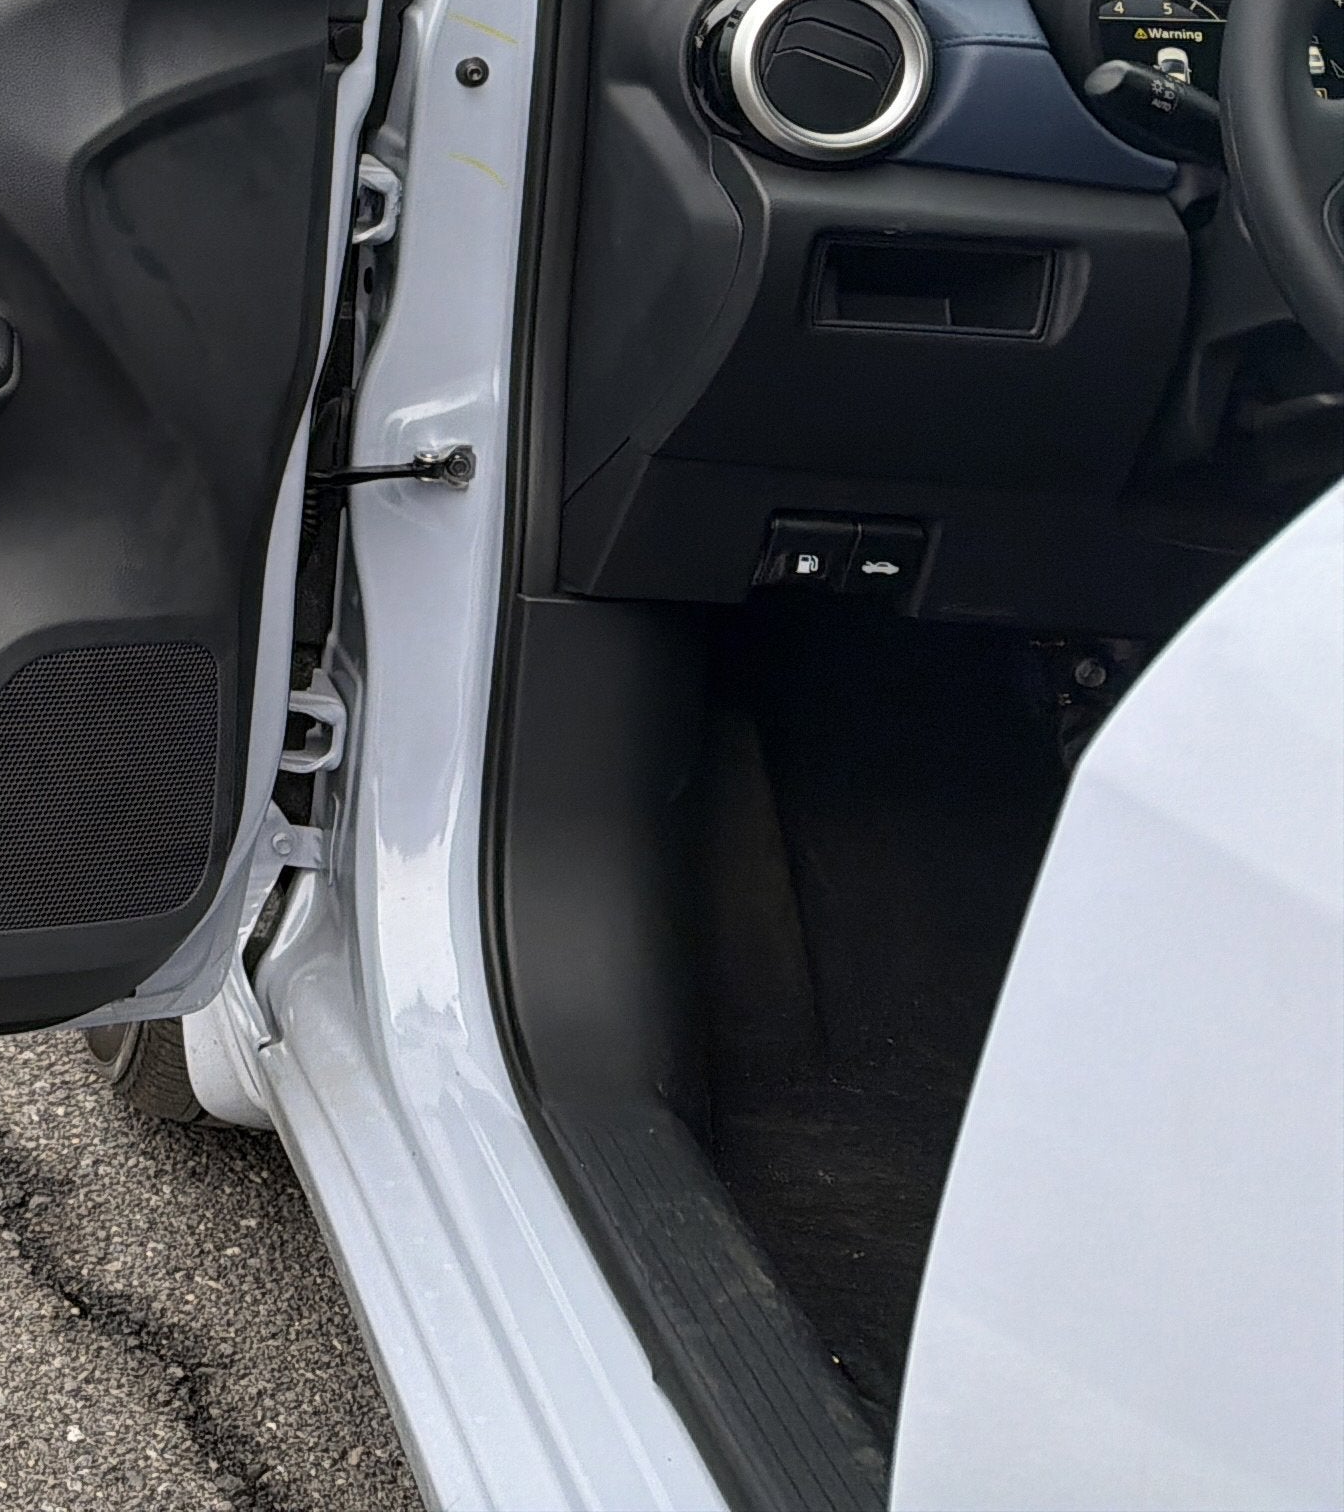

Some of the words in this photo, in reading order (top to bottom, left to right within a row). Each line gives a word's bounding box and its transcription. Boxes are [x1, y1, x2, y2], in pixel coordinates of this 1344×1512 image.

[1113, 2, 1125, 15] 4
[1162, 1, 1173, 15] 5
[1148, 28, 1203, 42] Warning
